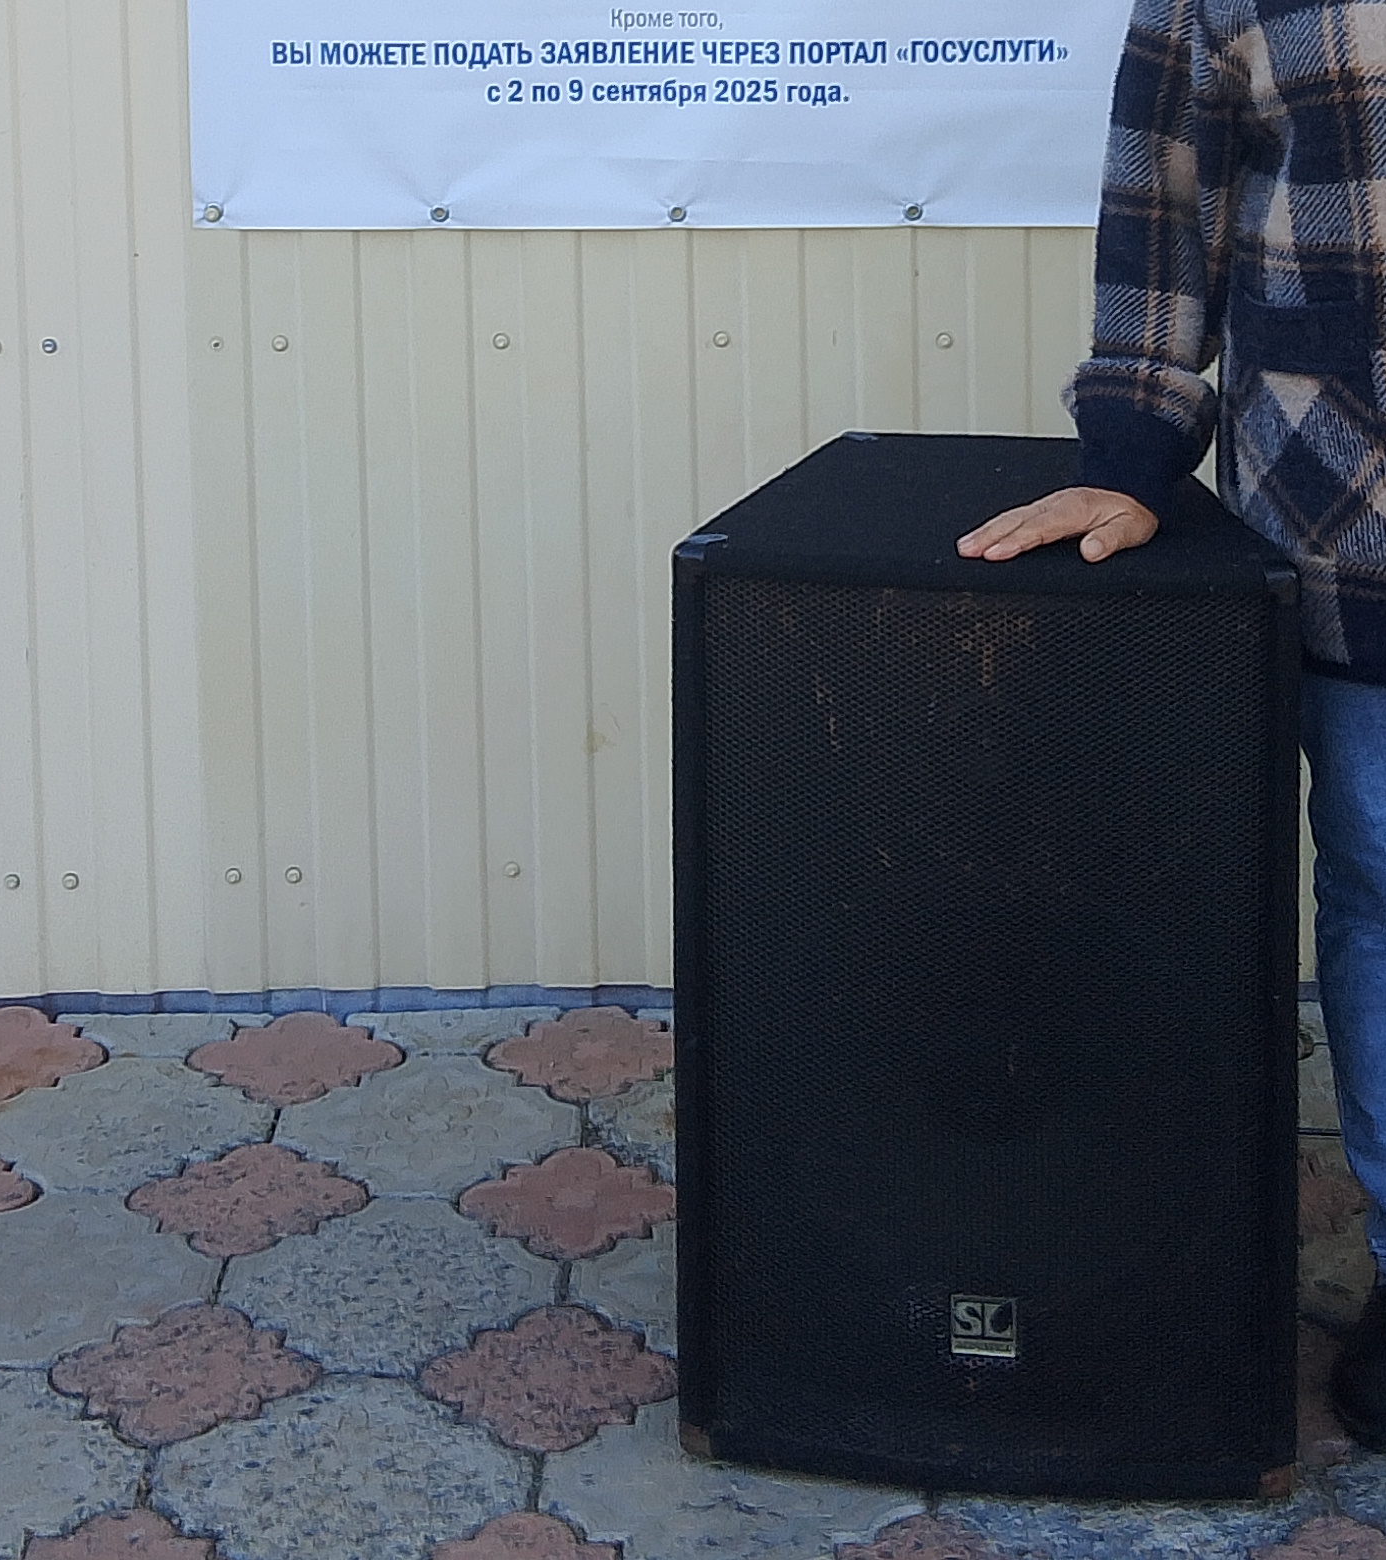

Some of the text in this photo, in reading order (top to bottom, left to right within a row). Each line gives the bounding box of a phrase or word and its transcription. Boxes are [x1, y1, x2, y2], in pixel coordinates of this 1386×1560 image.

[610, 7, 723, 33] Кроме того,
[271, 38, 1069, 70] ВЫ МОЖЕТЕ ПОДАТЬ ЗАЯВЛЕНИЕ ЧЕРЕЗ ПОРТАЛ «ГОСУСЛУГИ»
[486, 79, 850, 108] с 2 по 9 сентября 2025 года.
